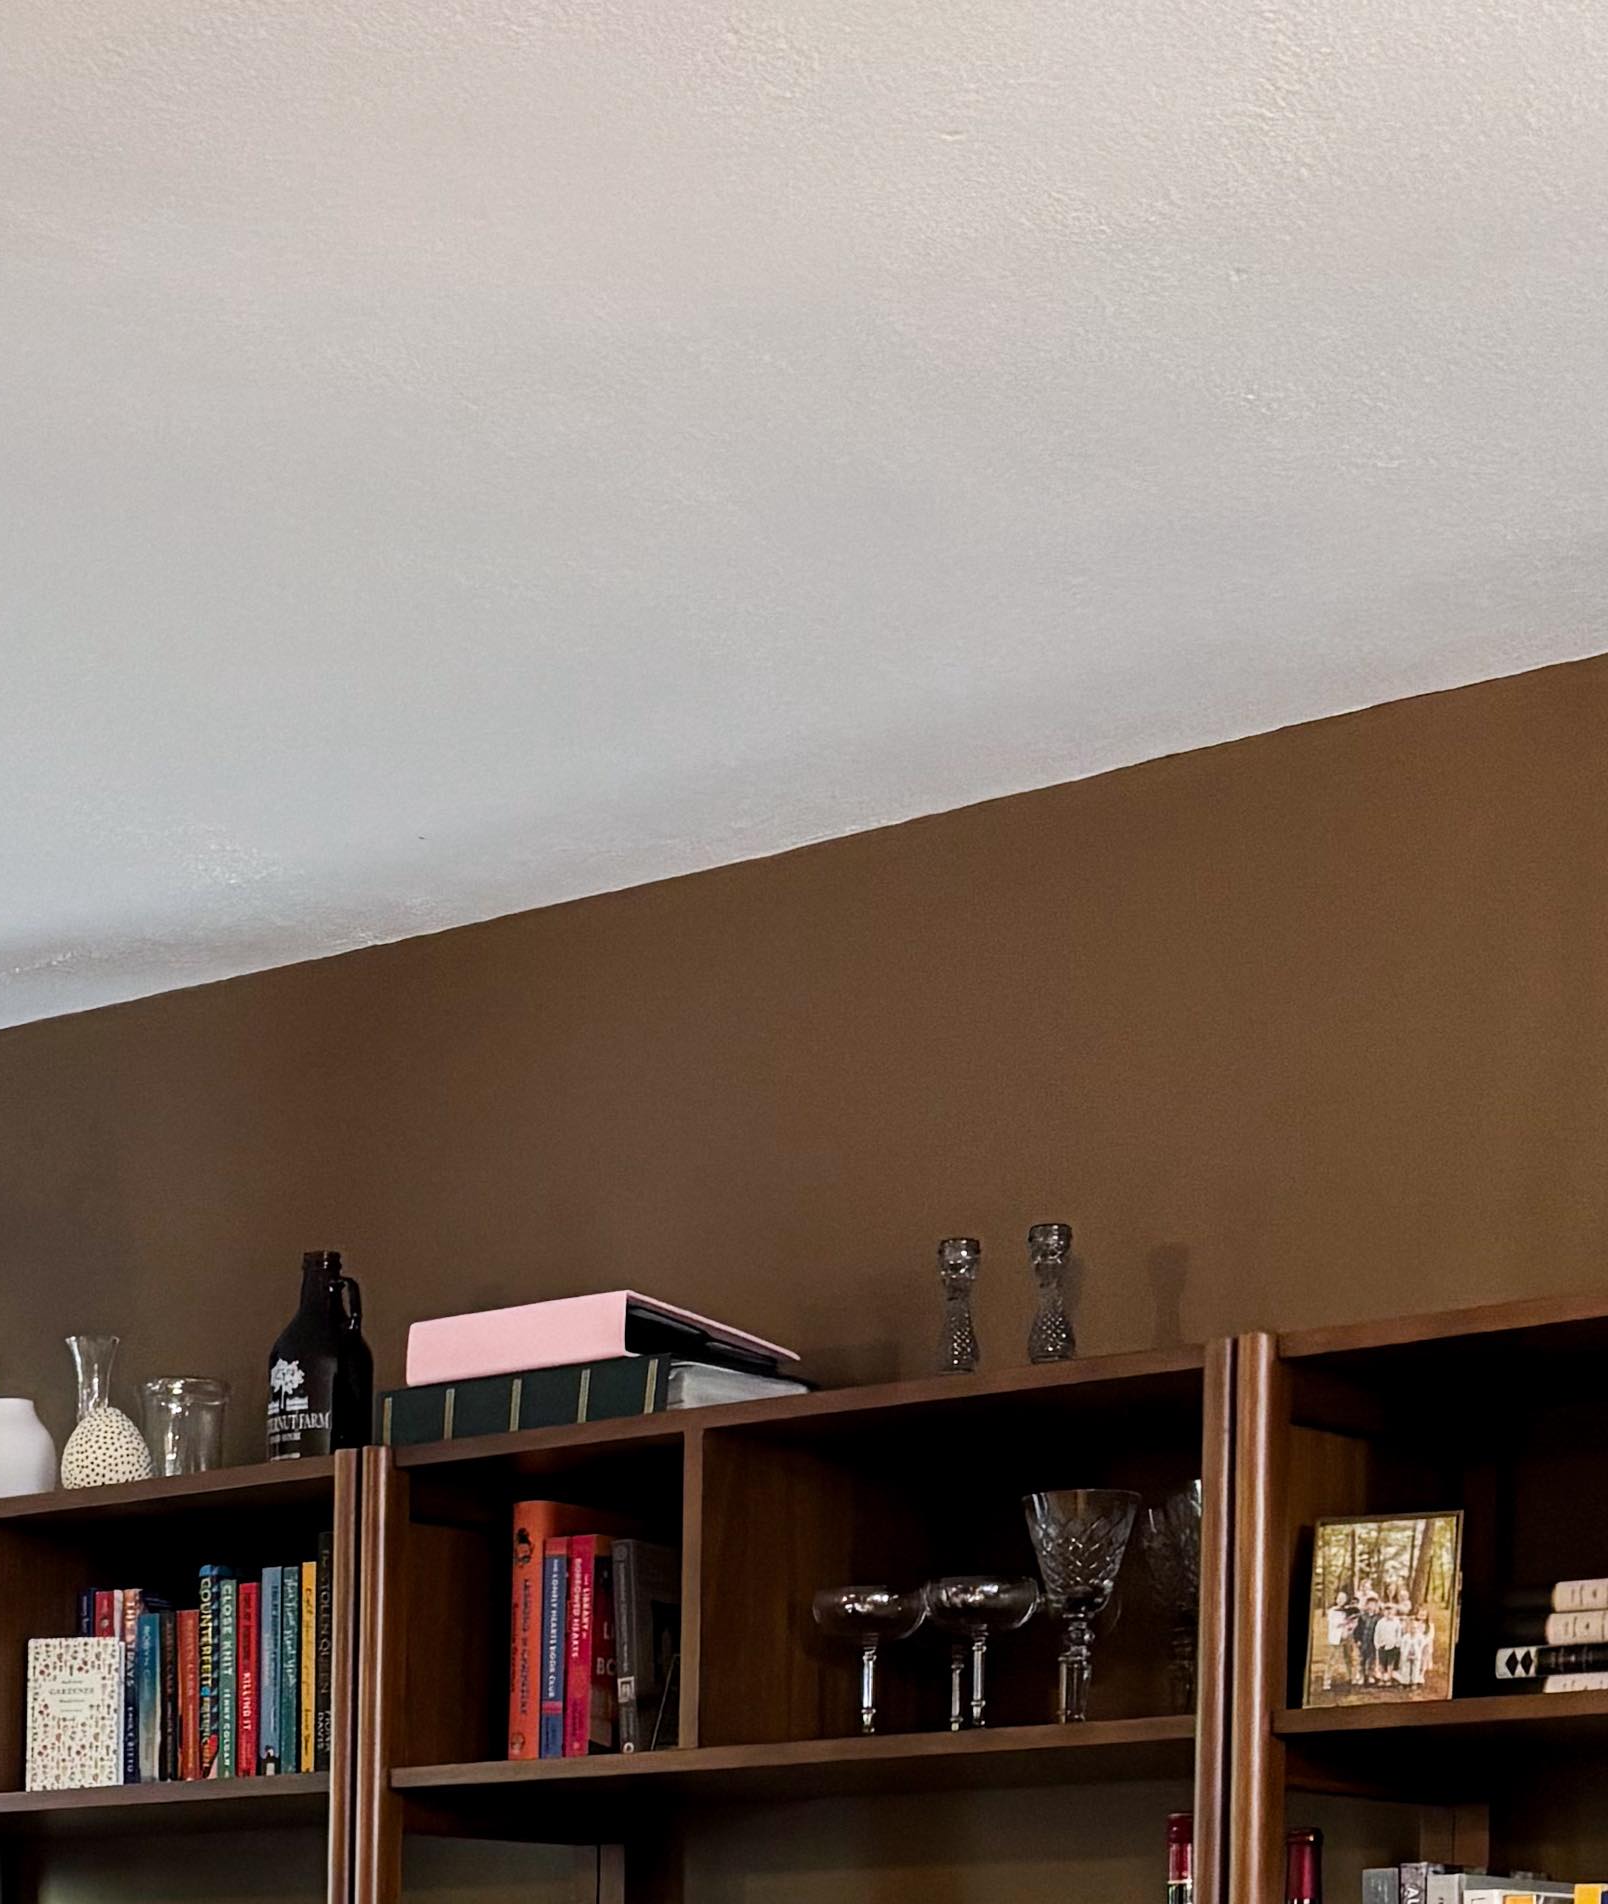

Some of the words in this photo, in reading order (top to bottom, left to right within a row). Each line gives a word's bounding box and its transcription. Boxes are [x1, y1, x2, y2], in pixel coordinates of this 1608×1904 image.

[299, 1412, 330, 1429] FARM
[319, 1574, 330, 1634] STOLEN
[573, 1558, 582, 1616] BORROWED
[223, 1585, 232, 1634] CLOSE
[549, 1610, 558, 1644] HEARTS
[582, 1588, 590, 1630] LIBRARY
[200, 1577, 212, 1686] COUNTERFEIT
[571, 1618, 581, 1657] HEARTS
[223, 1641, 232, 1676] KNIT
[320, 1638, 330, 1694] QUEEN
[242, 1672, 251, 1717] KILLING
[548, 1675, 556, 1698] CLUB
[223, 1723, 231, 1766] COLGAN
[243, 1719, 251, 1730] IT
[317, 1711, 325, 1750] DAVIS
